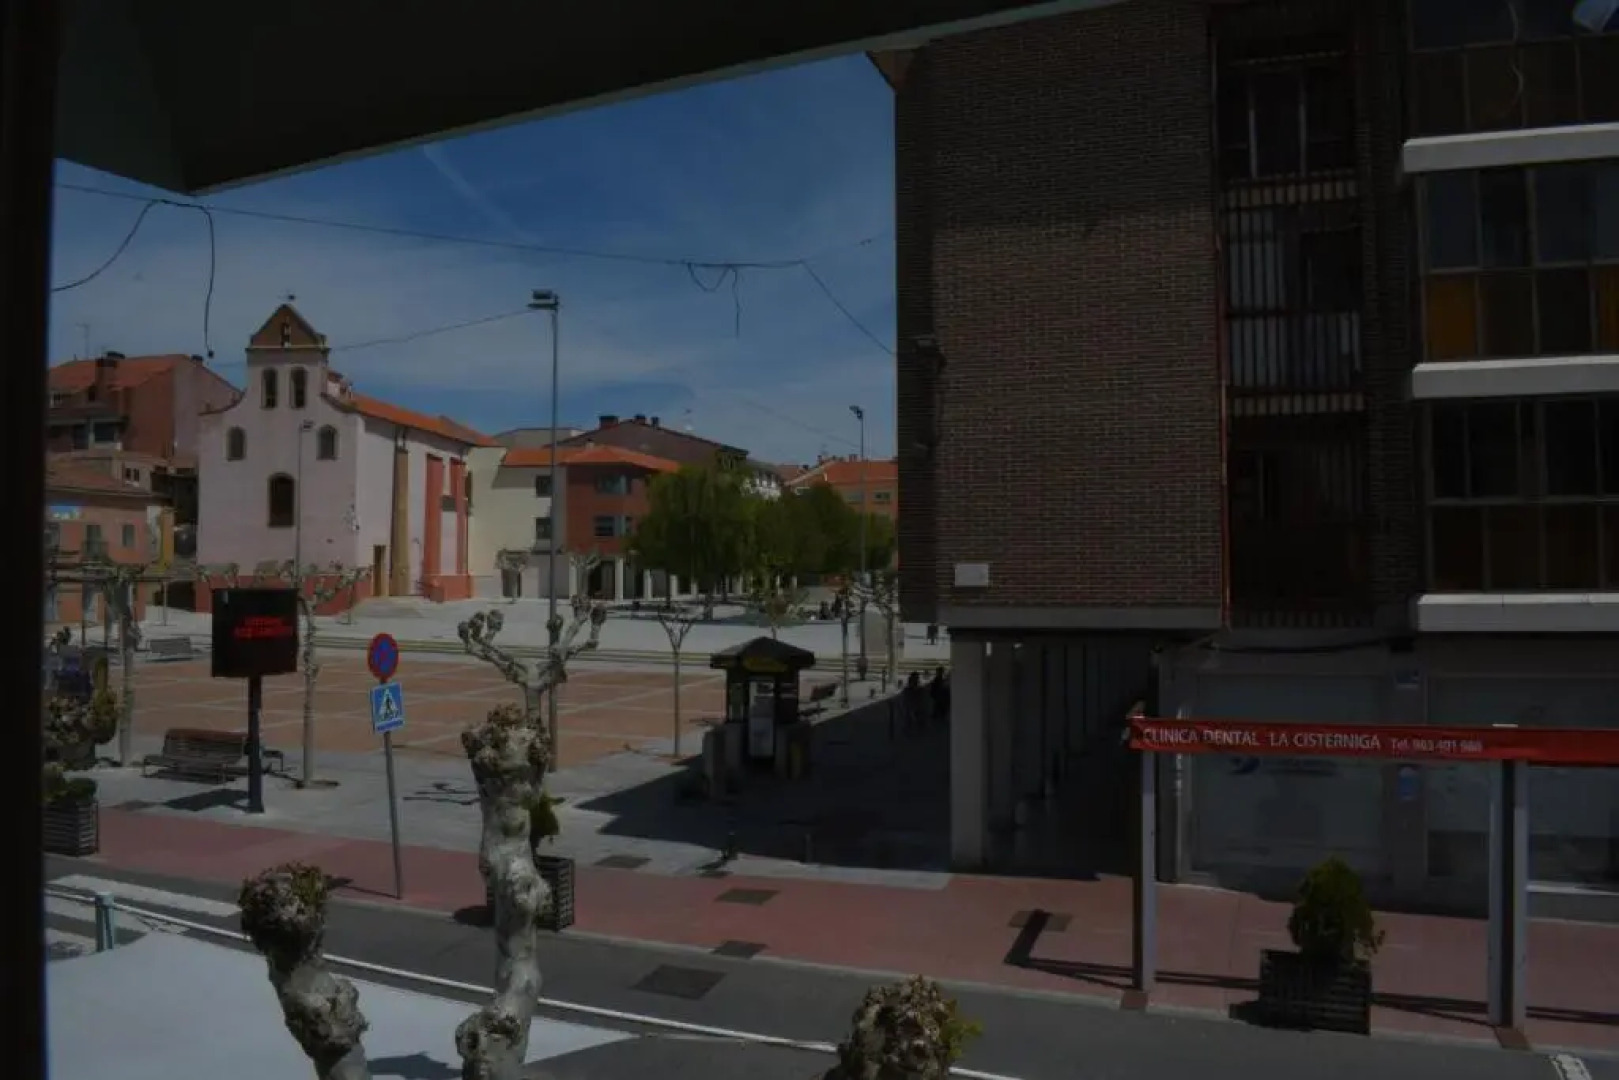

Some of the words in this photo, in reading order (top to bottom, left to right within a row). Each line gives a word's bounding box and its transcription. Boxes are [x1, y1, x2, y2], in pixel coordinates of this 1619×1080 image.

[1143, 727, 1199, 744] CLINICA
[1203, 728, 1260, 746] DENTAL
[1294, 731, 1382, 750] CISTERNIGA
